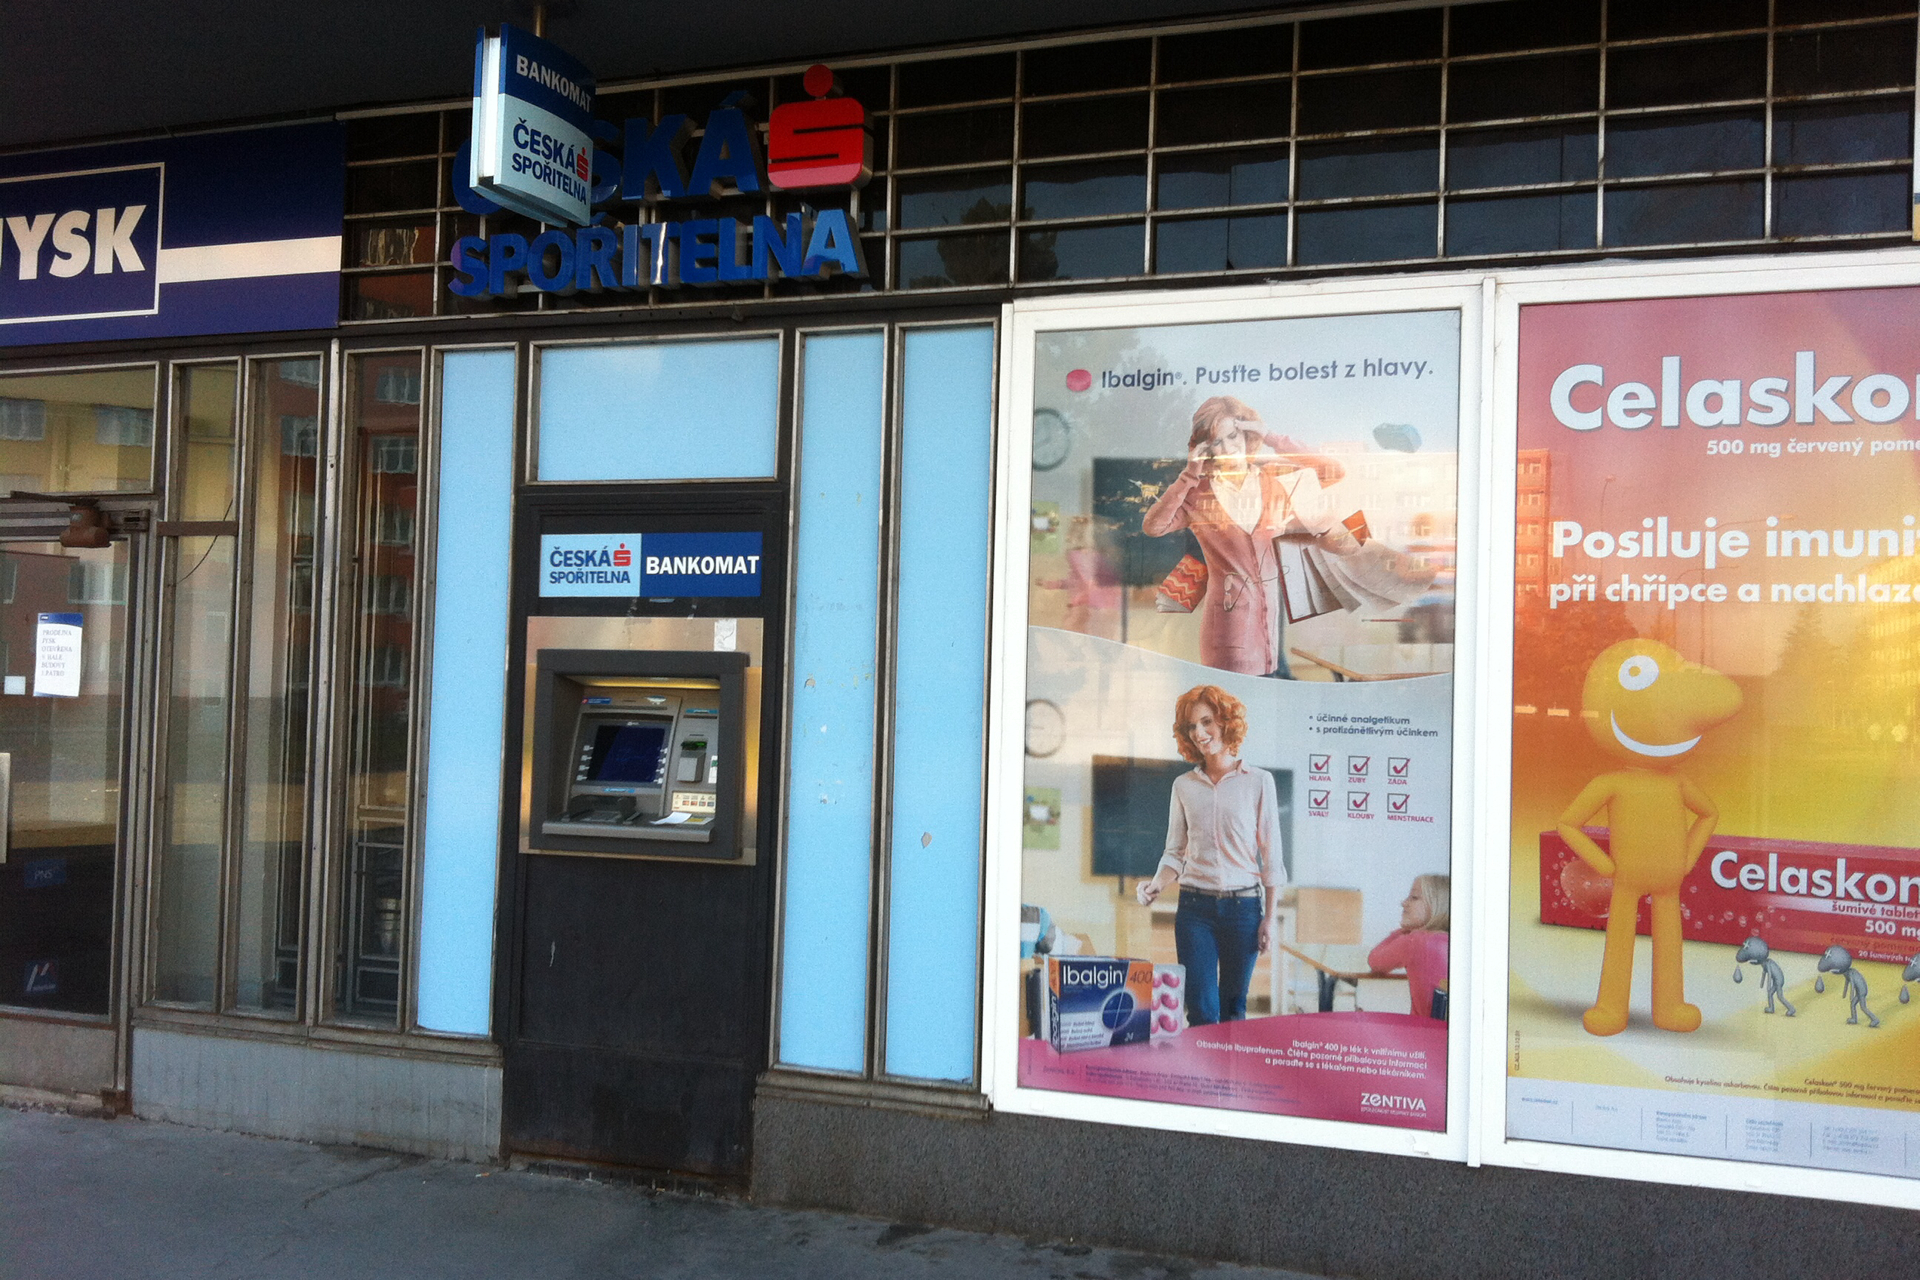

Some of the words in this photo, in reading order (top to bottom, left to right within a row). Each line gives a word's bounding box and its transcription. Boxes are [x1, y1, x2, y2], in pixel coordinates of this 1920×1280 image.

[516, 54, 592, 113] BANKOMAT
[452, 90, 760, 215] SKÁ
[513, 117, 576, 174] ČESKÁ
[512, 153, 587, 205] SPOŘITELNA
[0, 205, 147, 281] YSK
[447, 207, 860, 297] SPOŘITELNA
[1196, 364, 1261, 385] Pusťte
[1269, 360, 1339, 381] bolest
[1344, 363, 1356, 378] z
[1363, 358, 1434, 380] hlavy.
[1550, 350, 1920, 432] Celasko
[1706, 438, 1745, 455] 500
[1750, 441, 1782, 458] mg
[1787, 437, 1864, 457] červený
[1552, 516, 1750, 569] Posiluje
[1766, 514, 1920, 557] imuni
[550, 546, 612, 568] ČESKÁ
[646, 555, 760, 576] BANKOMAT
[549, 568, 631, 584] SPOŘITELNA
[1549, 574, 1596, 609] při
[1605, 573, 1728, 610] chřipce
[1738, 583, 1761, 602] a
[1316, 713, 1348, 723] účinné
[1350, 715, 1411, 725] analgetikum
[1323, 725, 1394, 737] protizánětlivým
[1396, 726, 1439, 737] účinkem
[1387, 814, 1434, 823] MENSTRUACE
[1711, 850, 1920, 907] Celaskon
[1831, 900, 1877, 915] šumivé
[1865, 919, 1897, 936] 500
[1063, 965, 1124, 989] Ibalgin
[1130, 970, 1152, 984] 400
[1196, 1040, 1233, 1052] Obsahuje
[1324, 1043, 1339, 1052] 400
[1340, 1044, 1348, 1053] je
[1349, 1044, 1362, 1054] lék
[1364, 1046, 1369, 1054] k
[1356, 1066, 1377, 1075] nebo
